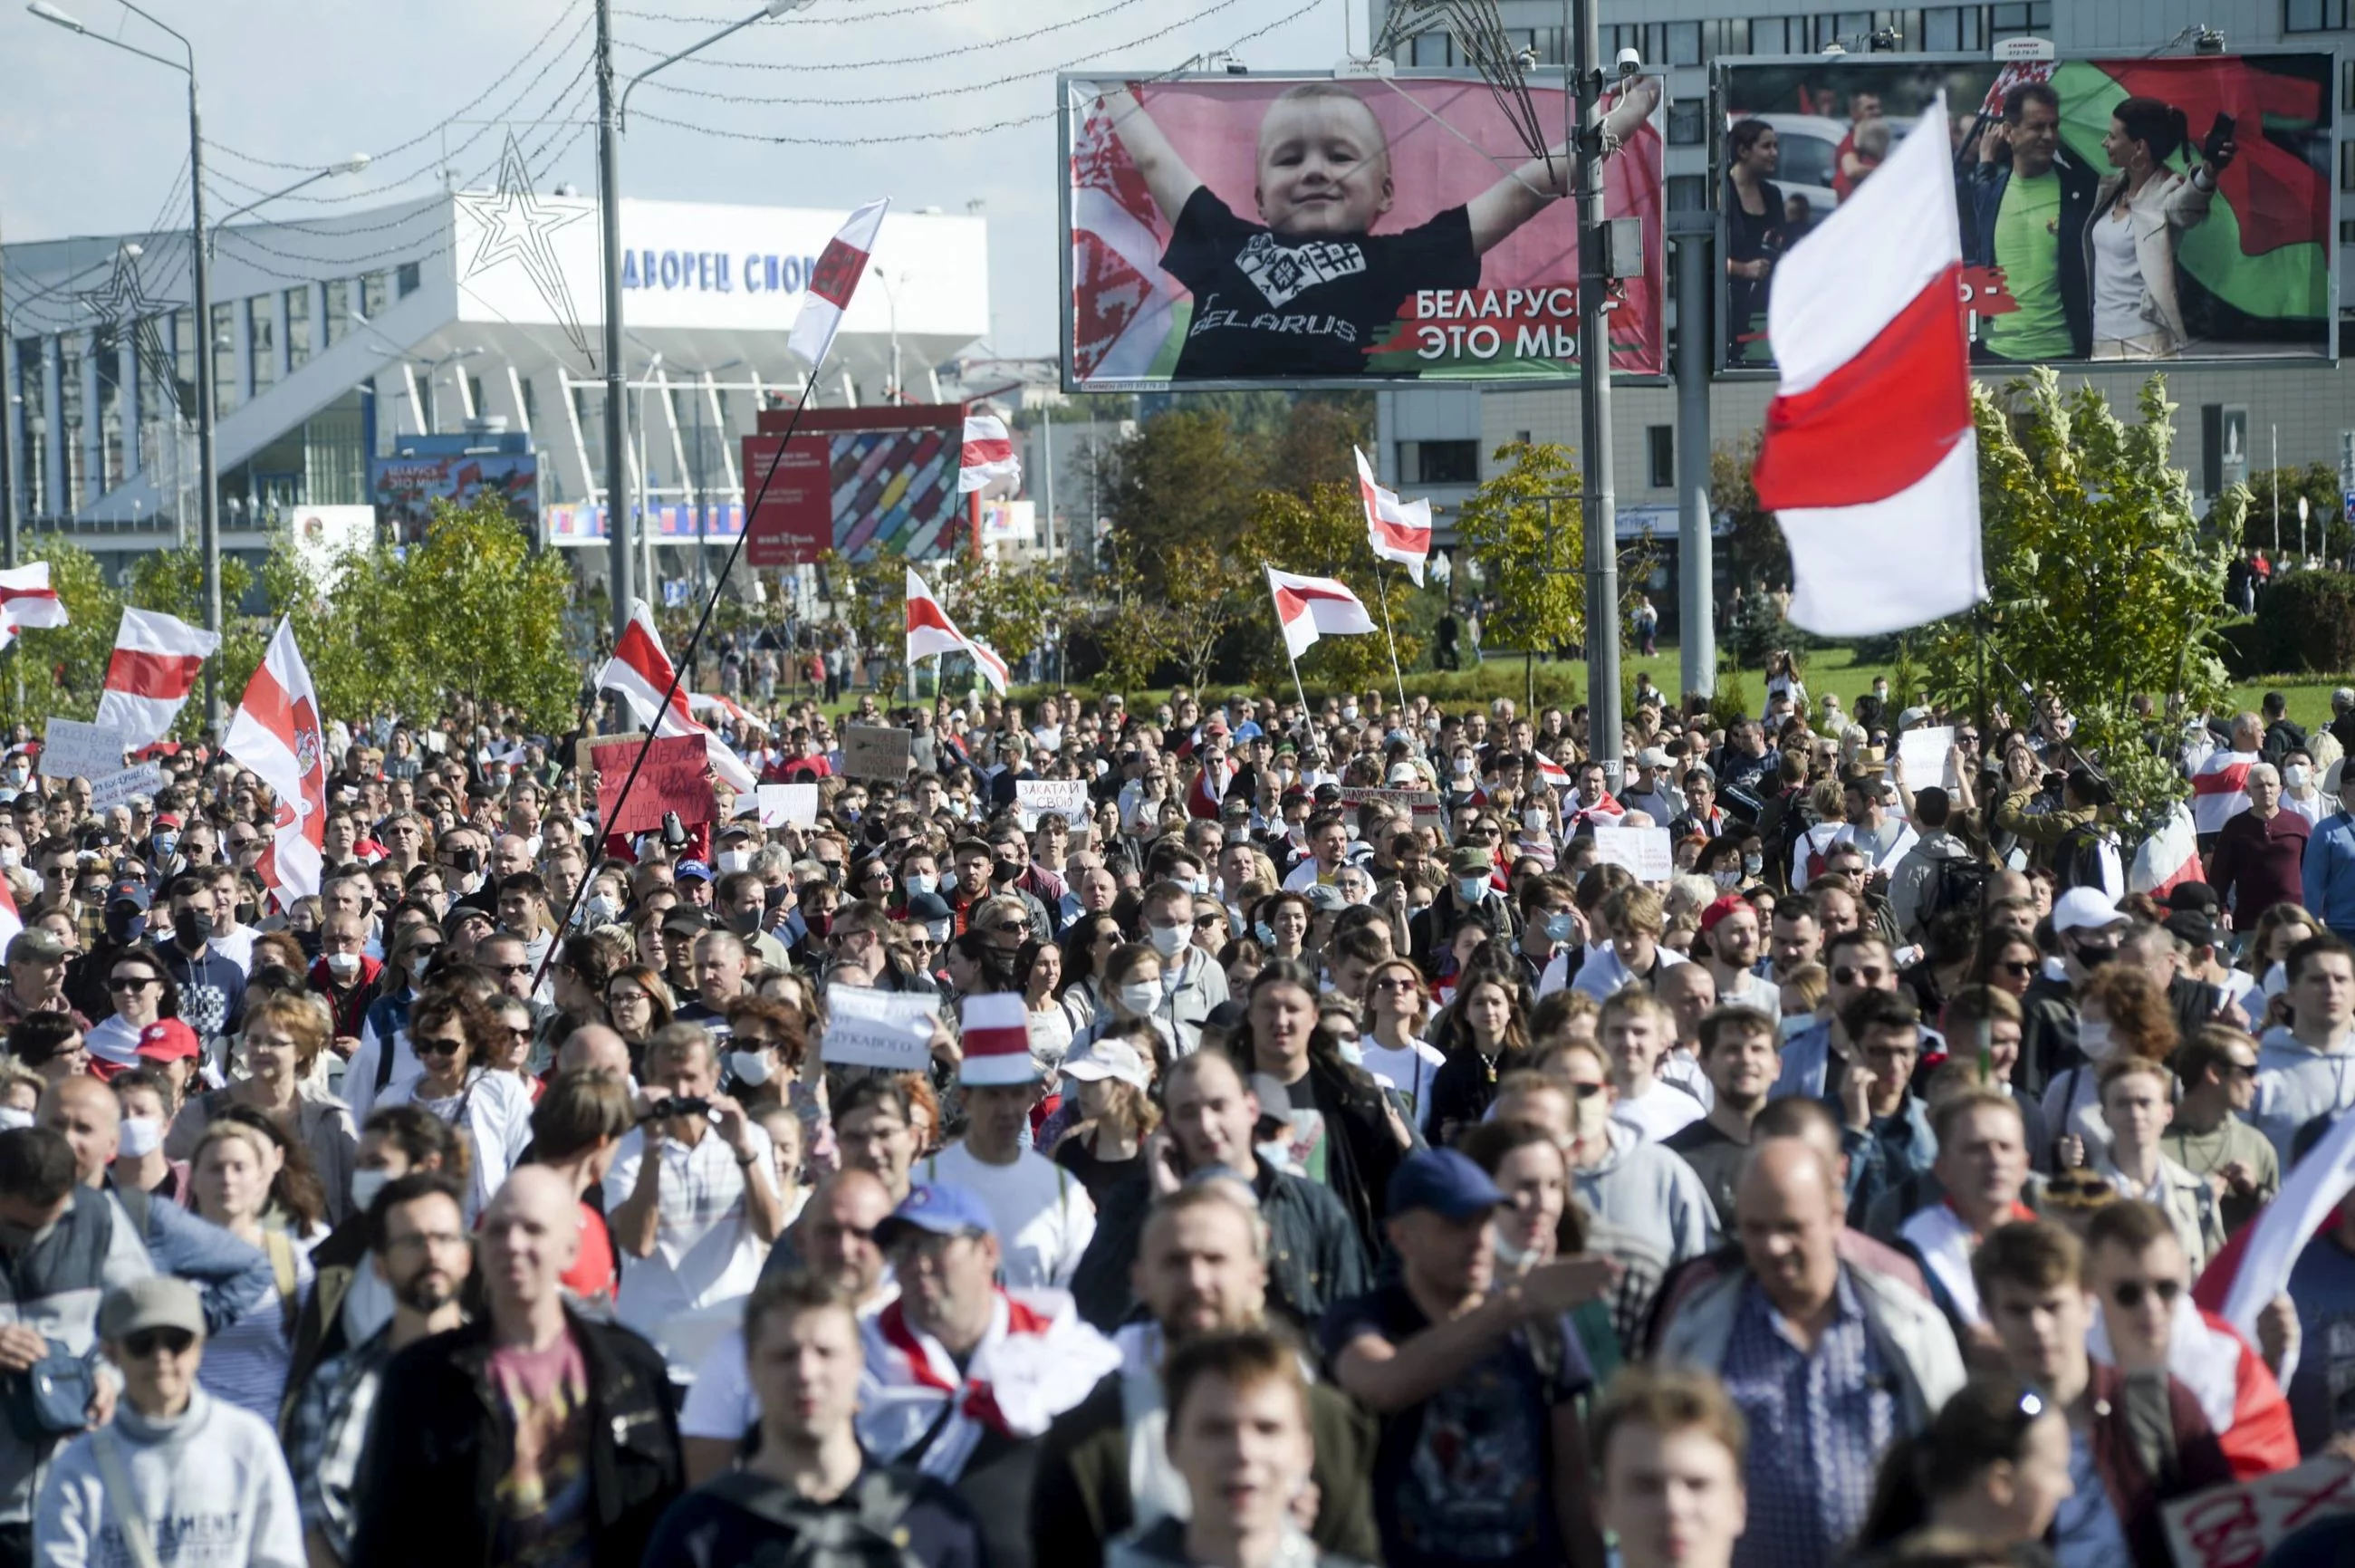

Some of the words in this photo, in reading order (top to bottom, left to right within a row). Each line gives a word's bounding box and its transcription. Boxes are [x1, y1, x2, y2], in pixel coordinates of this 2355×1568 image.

[622, 249, 733, 293] ДВОРЕЦ
[744, 253, 816, 294] СПОР
[1417, 289, 1581, 318] БЕЛАРУС
[1189, 309, 1358, 342] BELARUS
[1417, 325, 1502, 359] ЭТО
[1022, 782, 1080, 794] ЗАКАТАЙ
[1036, 797, 1073, 809] СВОЮ
